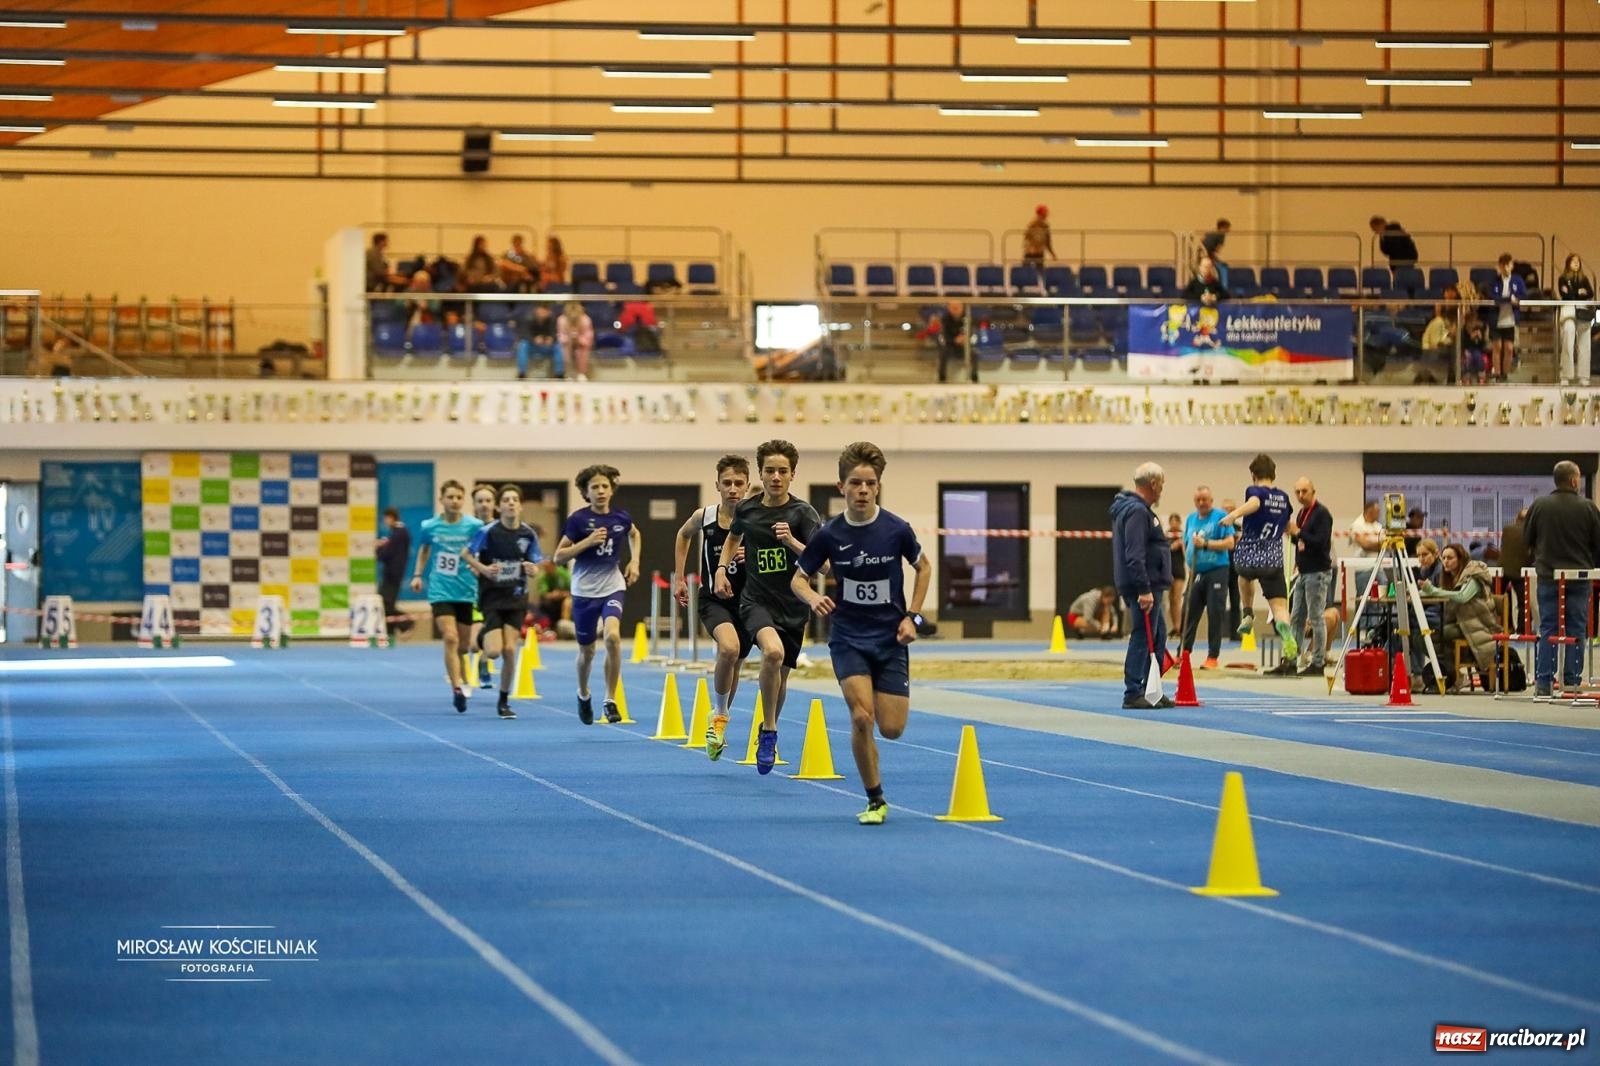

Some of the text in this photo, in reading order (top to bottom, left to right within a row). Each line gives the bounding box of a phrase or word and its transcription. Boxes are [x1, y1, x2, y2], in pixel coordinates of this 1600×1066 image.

[1226, 314, 1321, 333] Lekkoatletyka
[596, 538, 614, 556] 34
[439, 555, 456, 571] 39
[759, 549, 786, 571] 563
[865, 556, 880, 565] DGI
[855, 583, 878, 601] 63
[260, 606, 273, 634] 3
